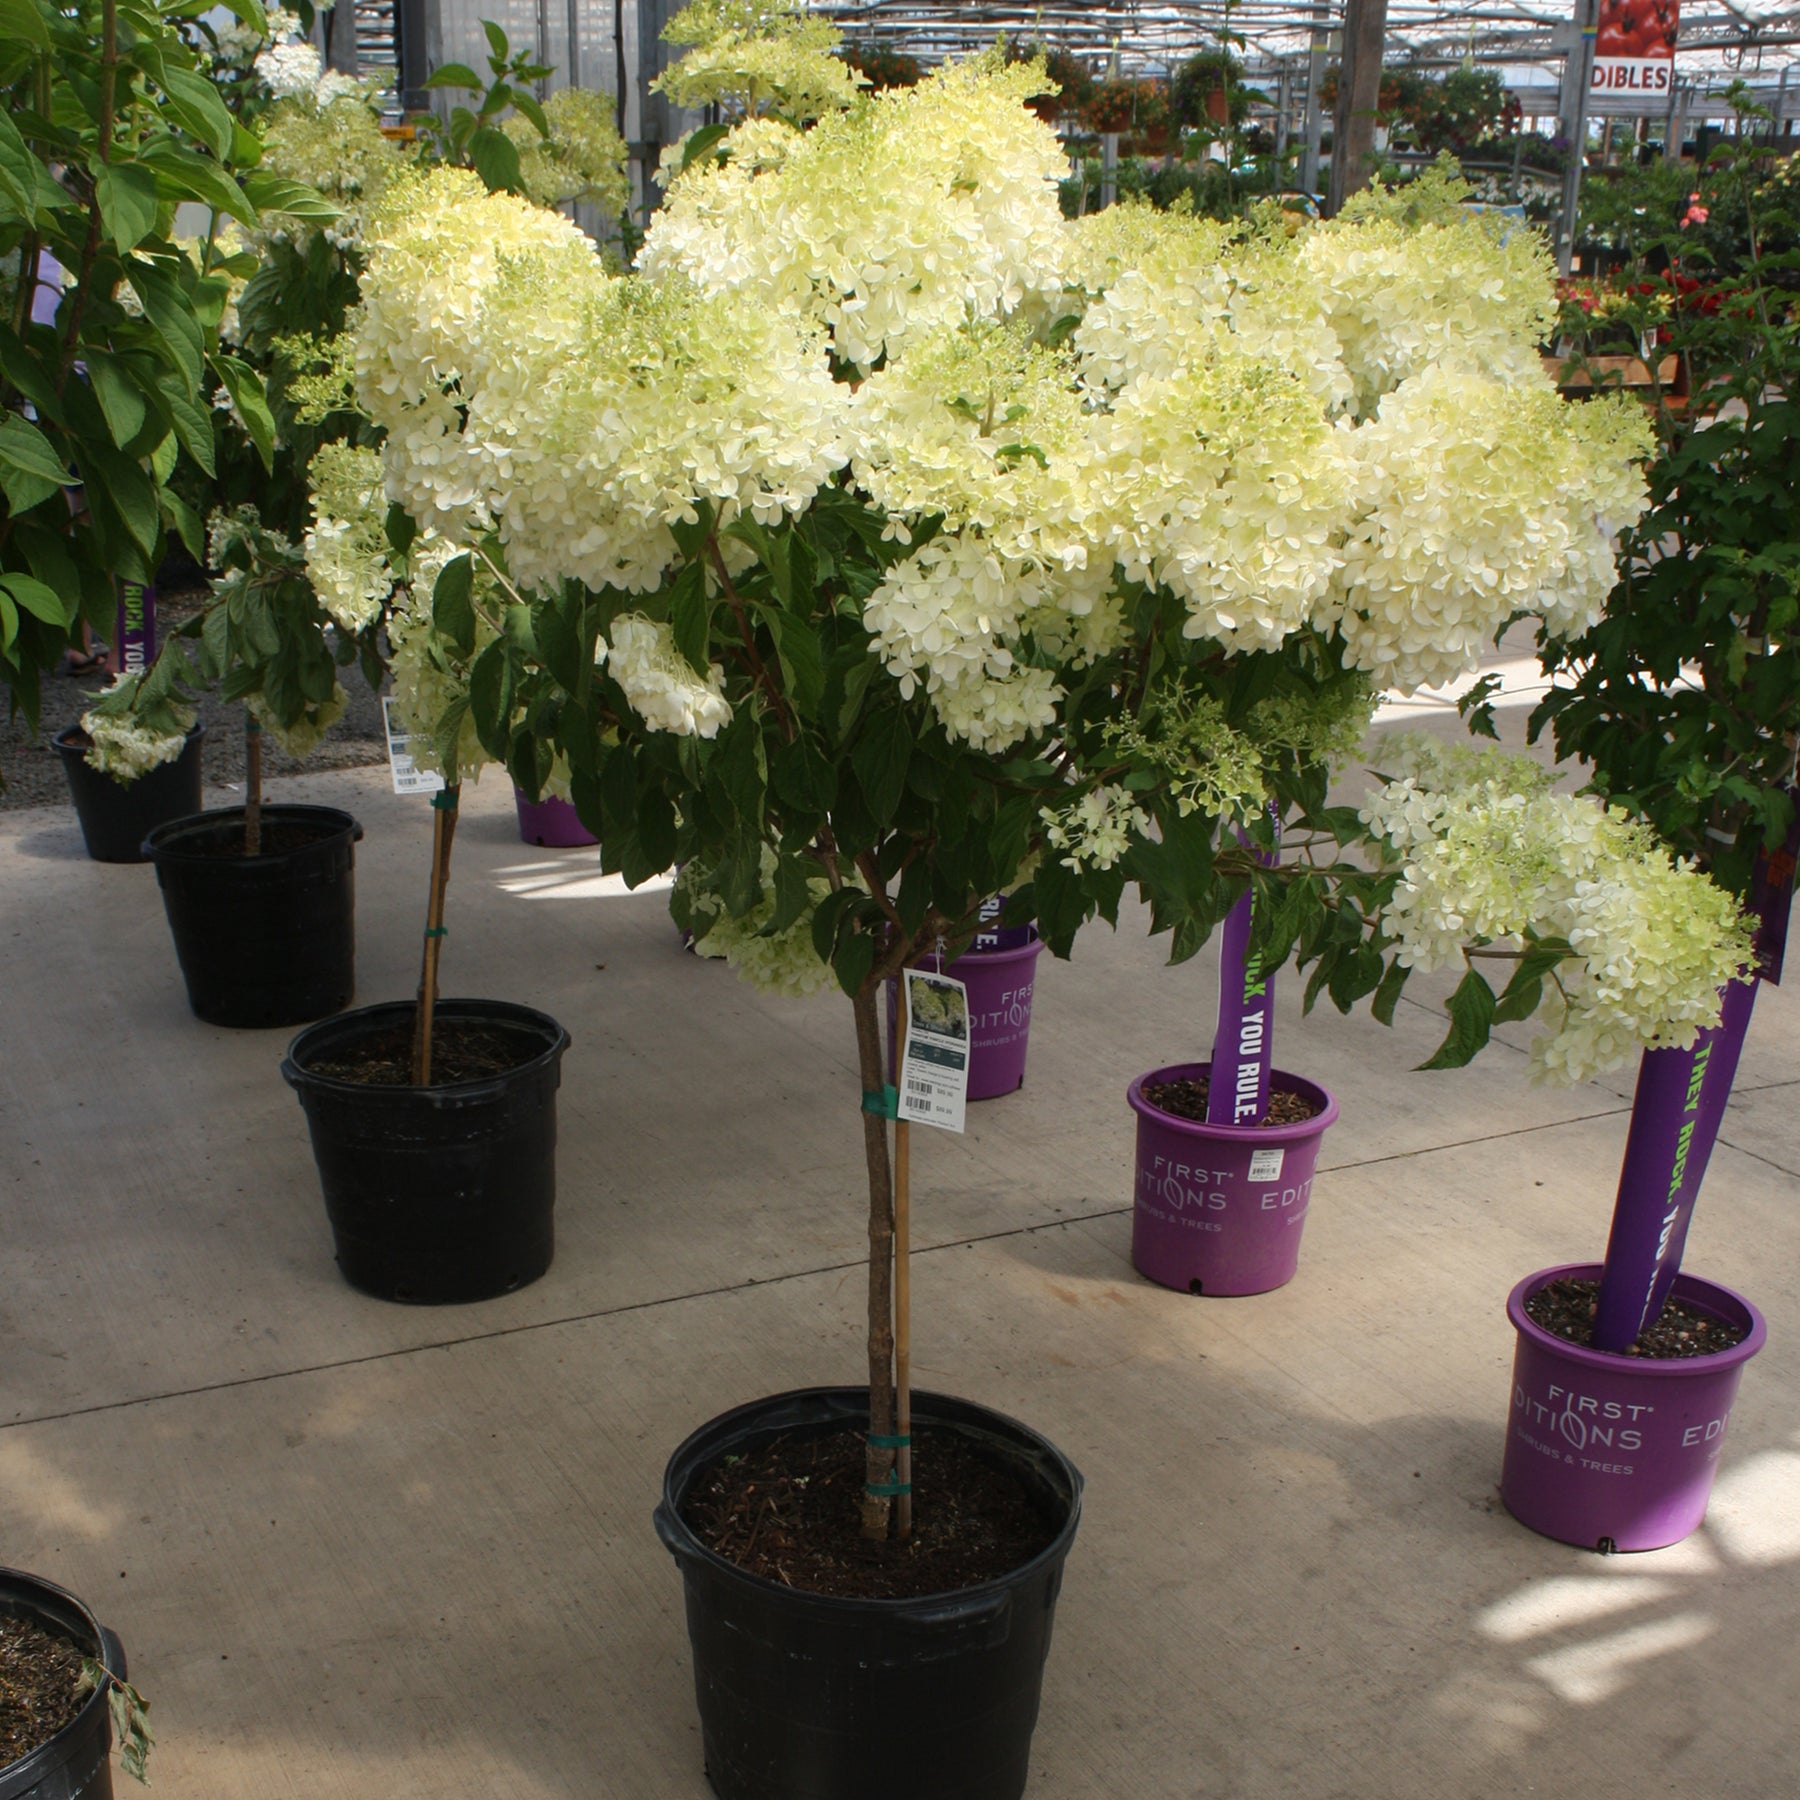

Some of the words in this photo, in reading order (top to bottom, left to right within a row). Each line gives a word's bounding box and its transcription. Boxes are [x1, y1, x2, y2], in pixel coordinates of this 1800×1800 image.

[977, 898, 1000, 949] RUE.
[1239, 1010, 1264, 1055] YOU
[1234, 1062, 1260, 1124] RULE.
[1684, 1040, 1713, 1113] THEY
[1667, 1119, 1695, 1204] ROCK.
[1181, 1217, 1223, 1232] TREES
[1580, 1458, 1634, 1475] TREES
